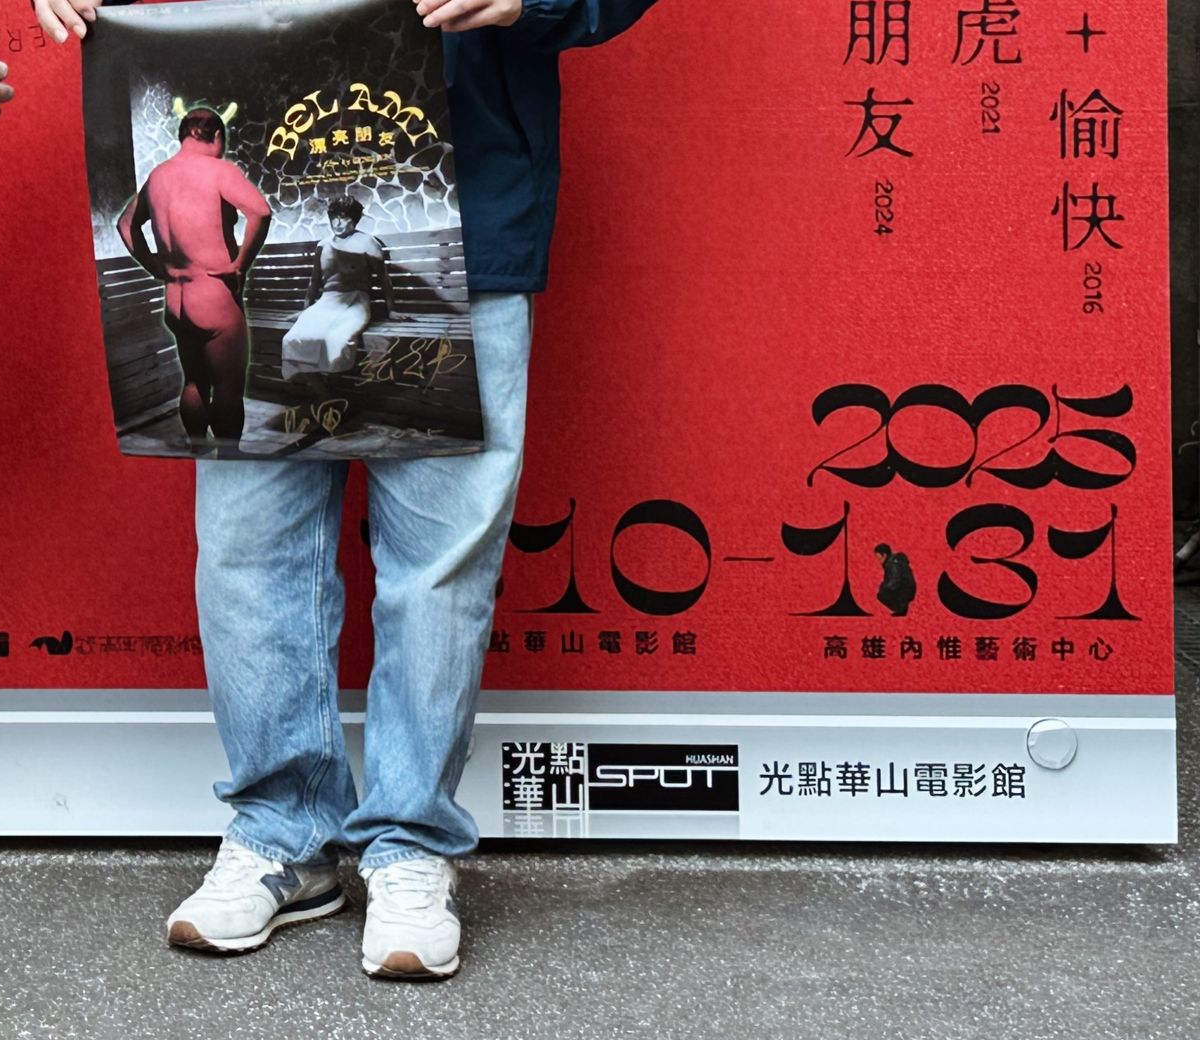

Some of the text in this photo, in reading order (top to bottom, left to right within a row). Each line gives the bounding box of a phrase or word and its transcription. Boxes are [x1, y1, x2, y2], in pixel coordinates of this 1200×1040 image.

[266, 90, 339, 160] BEL
[981, 81, 1001, 135] 2021
[873, 179, 895, 237] 2024
[1081, 262, 1104, 315] 2016
[806, 383, 1138, 490] 2025
[823, 636, 1114, 661] 高雄內惟藝術中心
[589, 765, 738, 788] SPOT
[685, 754, 734, 765] HUASHAN
[759, 761, 1027, 799] 光點華山電影館
